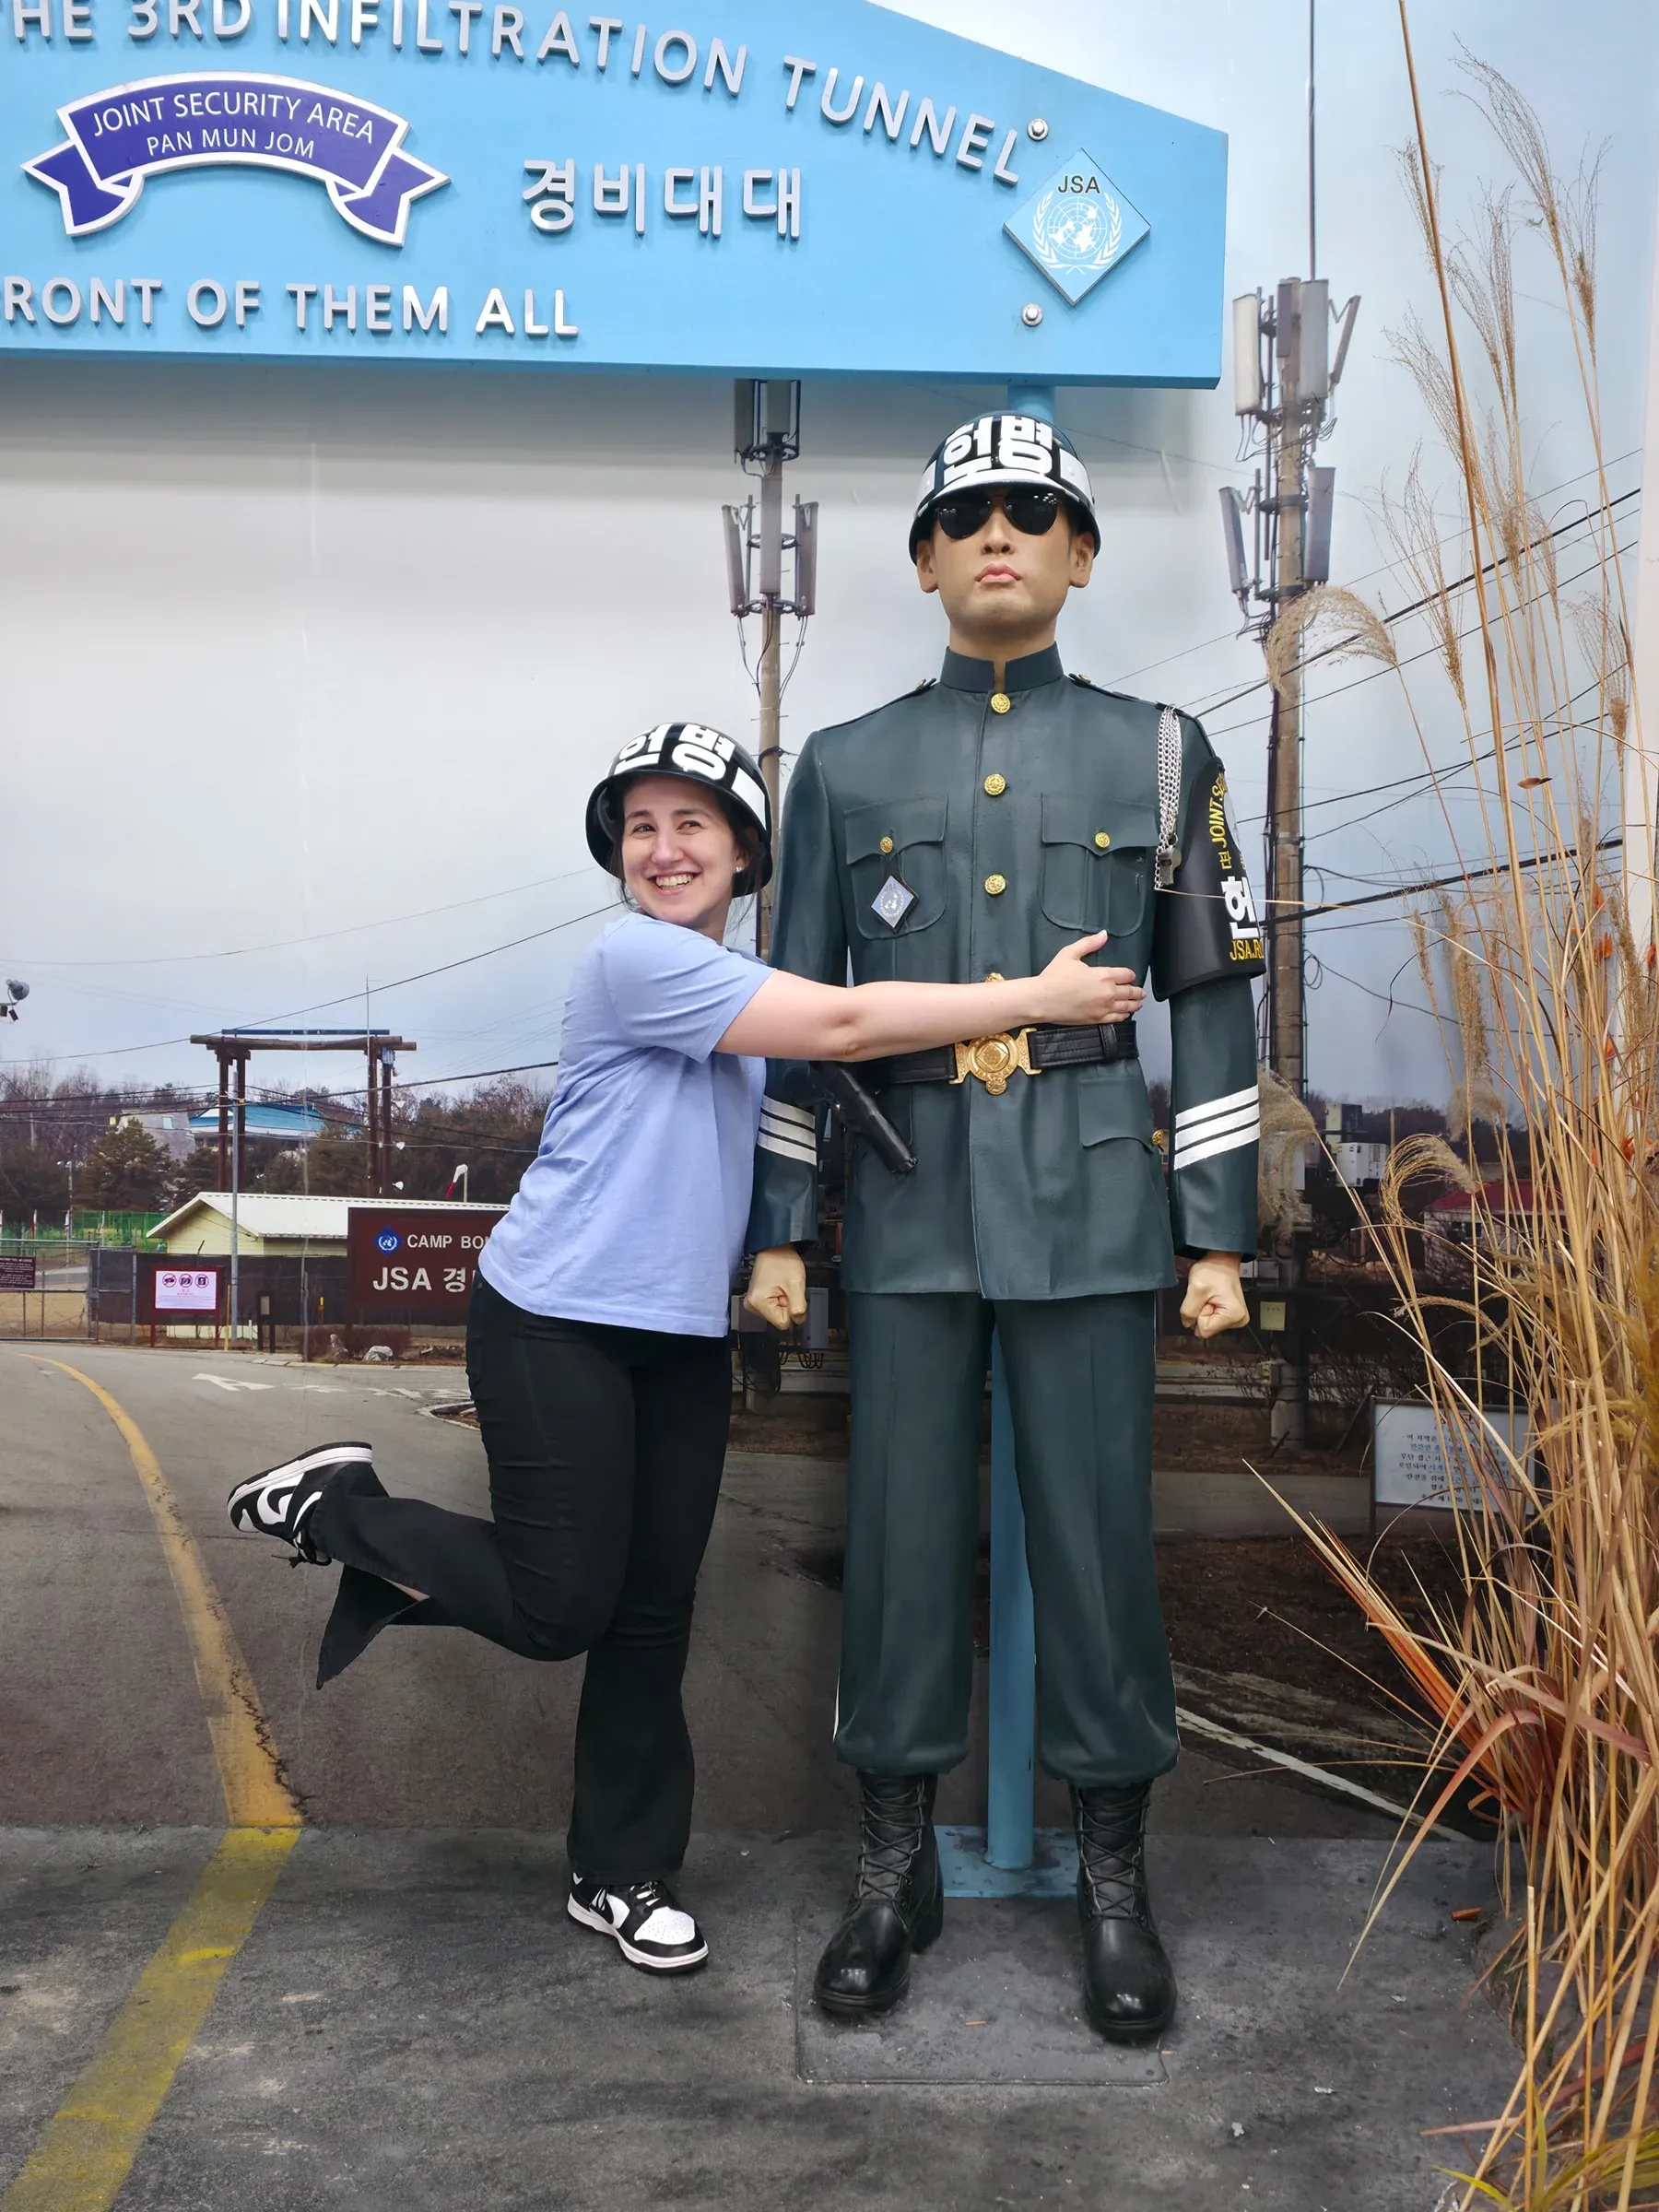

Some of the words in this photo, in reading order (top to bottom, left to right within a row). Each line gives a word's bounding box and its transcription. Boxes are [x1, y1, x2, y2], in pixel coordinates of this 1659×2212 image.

[94, 96, 165, 136] JOINT
[173, 91, 302, 121] SECURITY
[307, 102, 373, 144] AREA
[127, 0, 252, 40] 3RD
[278, 0, 747, 96] INFILTRATION
[782, 55, 1019, 186] TUNNEL
[147, 130, 193, 157] PAN
[202, 128, 256, 148] MUN
[265, 131, 314, 159] JOM
[523, 158, 802, 241] 경비대대
[1057, 173, 1101, 194] JSA
[186, 278, 261, 327] OF
[286, 283, 449, 334] THEM
[475, 288, 580, 337] ALL
[943, 416, 1053, 485] 헌병
[614, 723, 735, 781] 헌병
[406, 1233, 453, 1249] CAMP
[372, 1266, 432, 1291] JSA
[443, 1267, 476, 1293] 경
